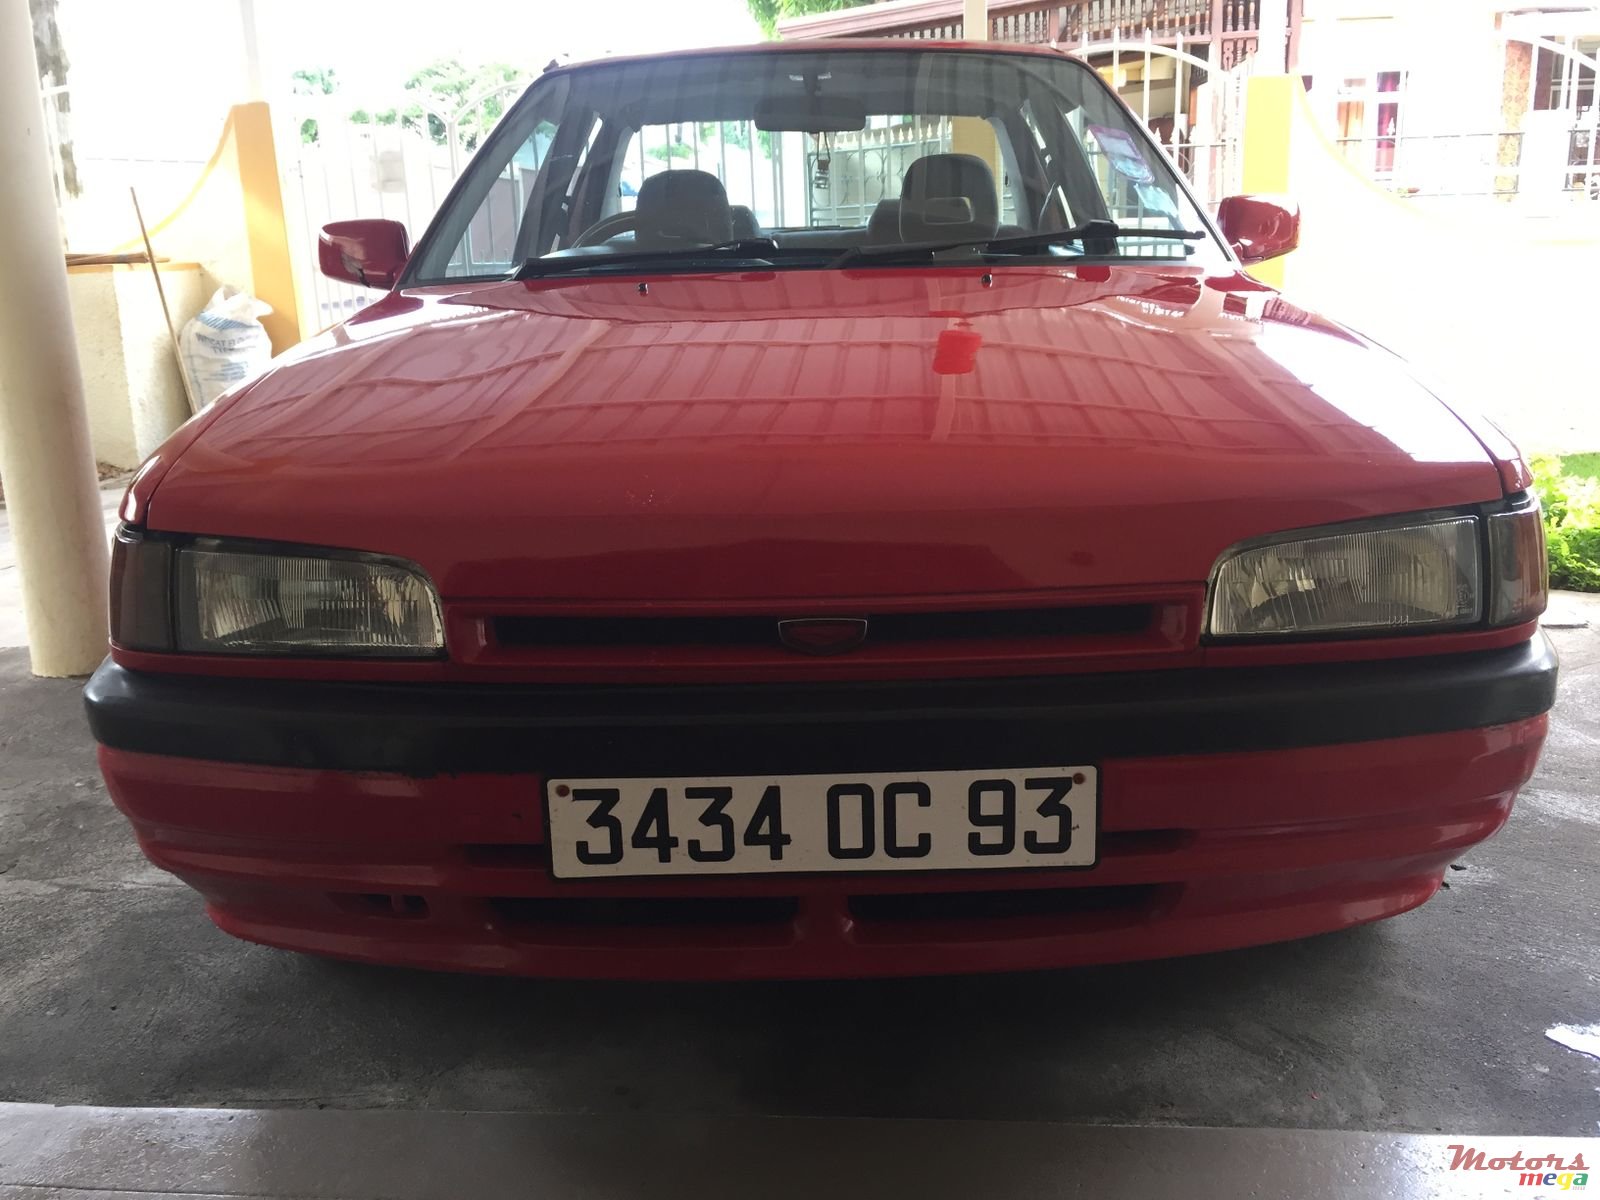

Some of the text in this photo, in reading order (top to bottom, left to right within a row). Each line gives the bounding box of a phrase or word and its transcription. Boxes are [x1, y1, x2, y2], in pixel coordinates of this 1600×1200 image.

[572, 776, 1074, 865] 3434 OC 93
